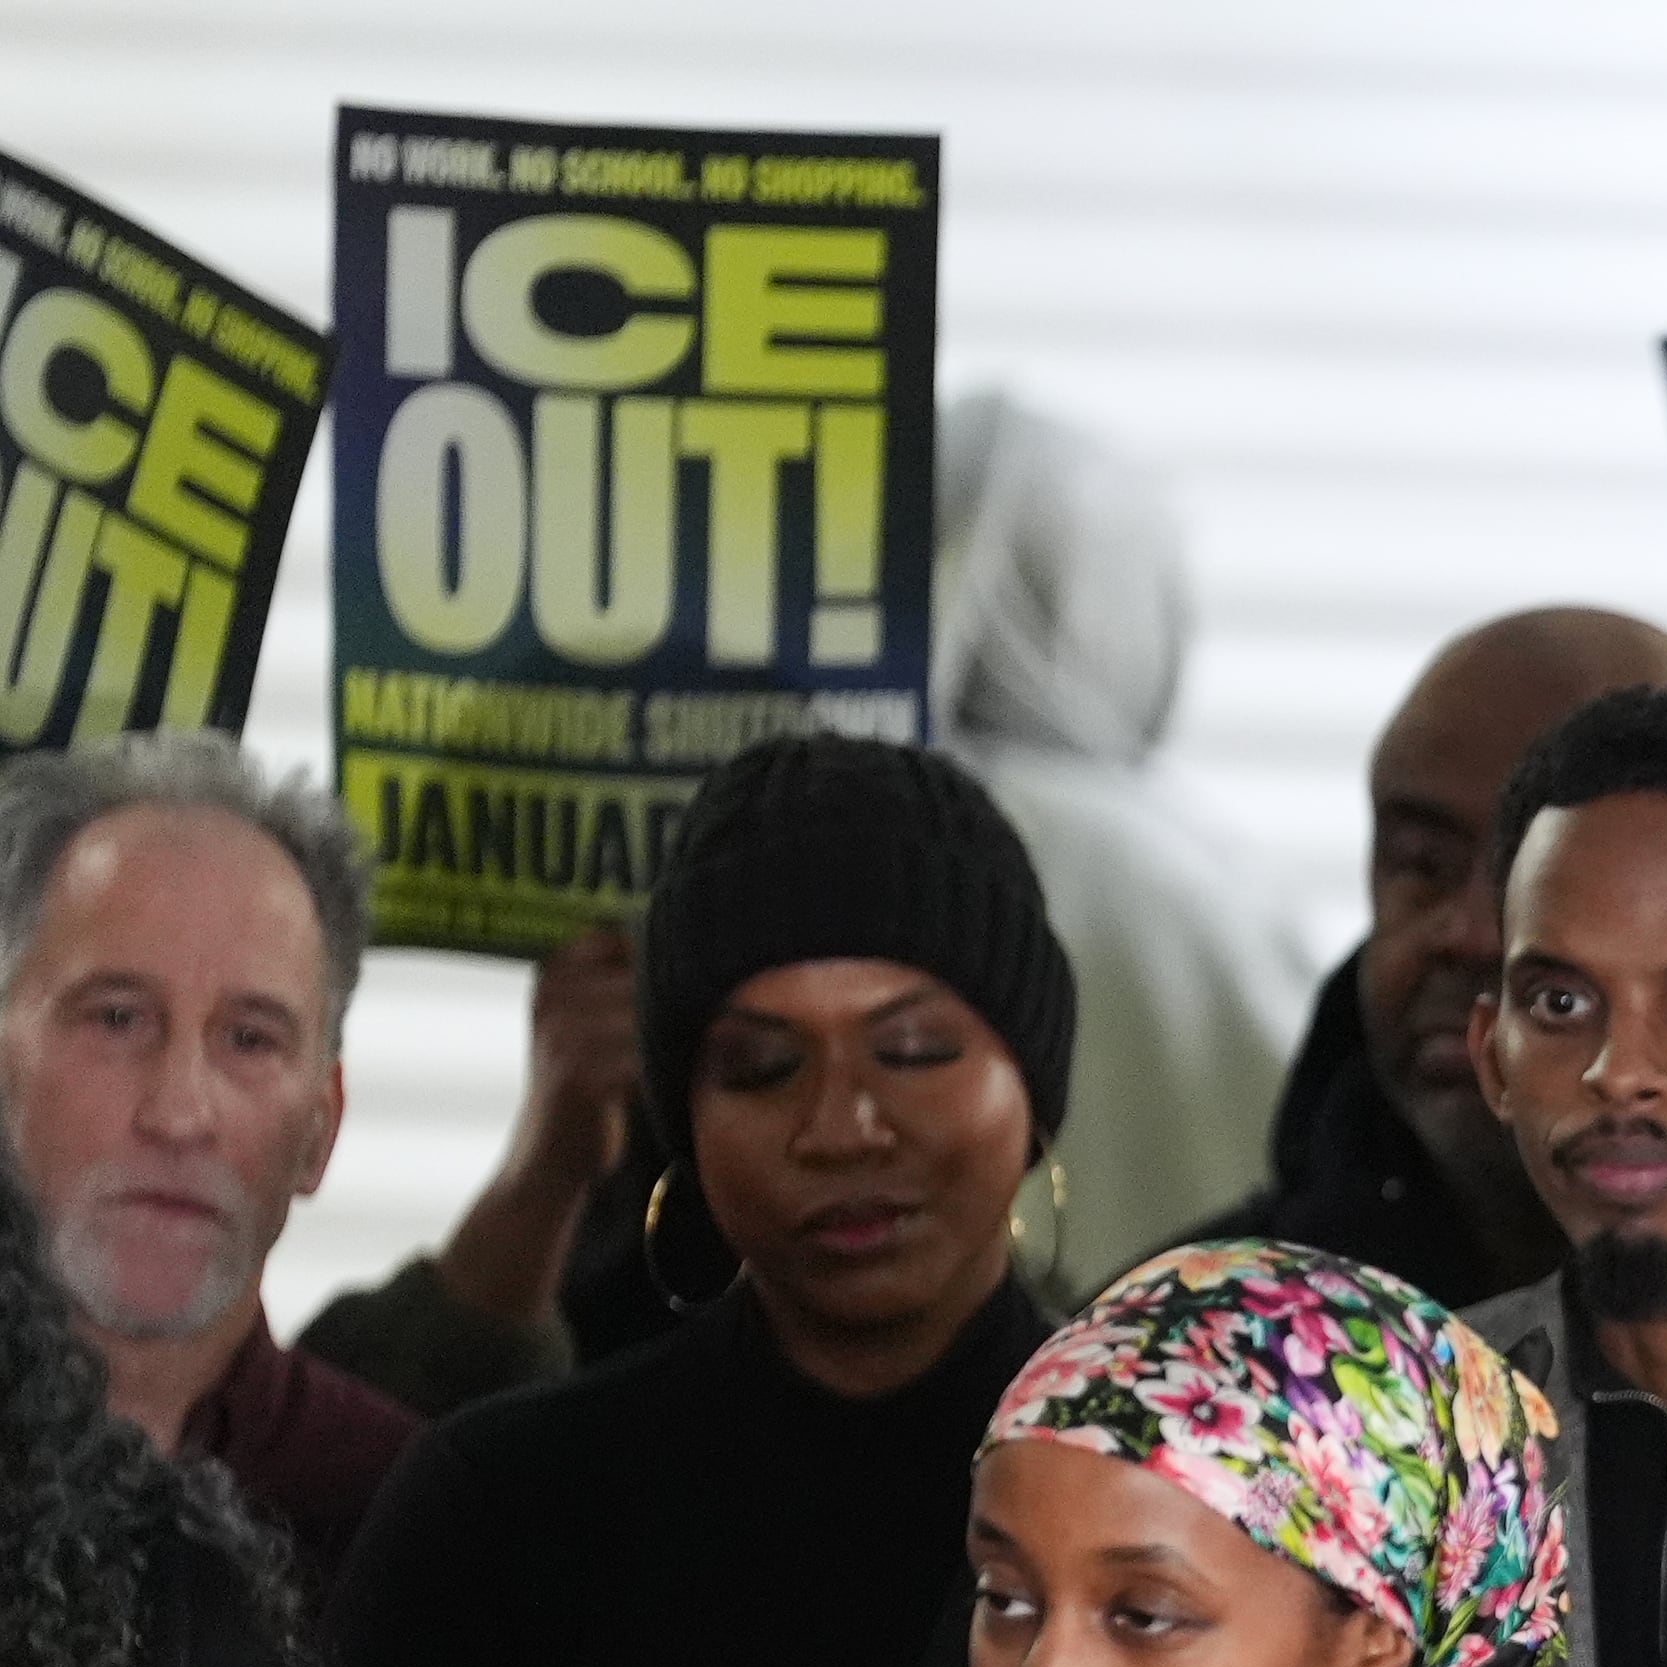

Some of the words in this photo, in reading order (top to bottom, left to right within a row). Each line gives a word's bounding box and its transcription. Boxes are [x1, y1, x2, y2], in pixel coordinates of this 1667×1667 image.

[351, 130, 399, 183] NO
[508, 144, 558, 193] NO
[701, 153, 750, 203] NO
[384, 203, 887, 396] ICE
[0, 458, 238, 745] UT!
[375, 383, 887, 668] OUT!
[378, 775, 692, 893] JANUAR
